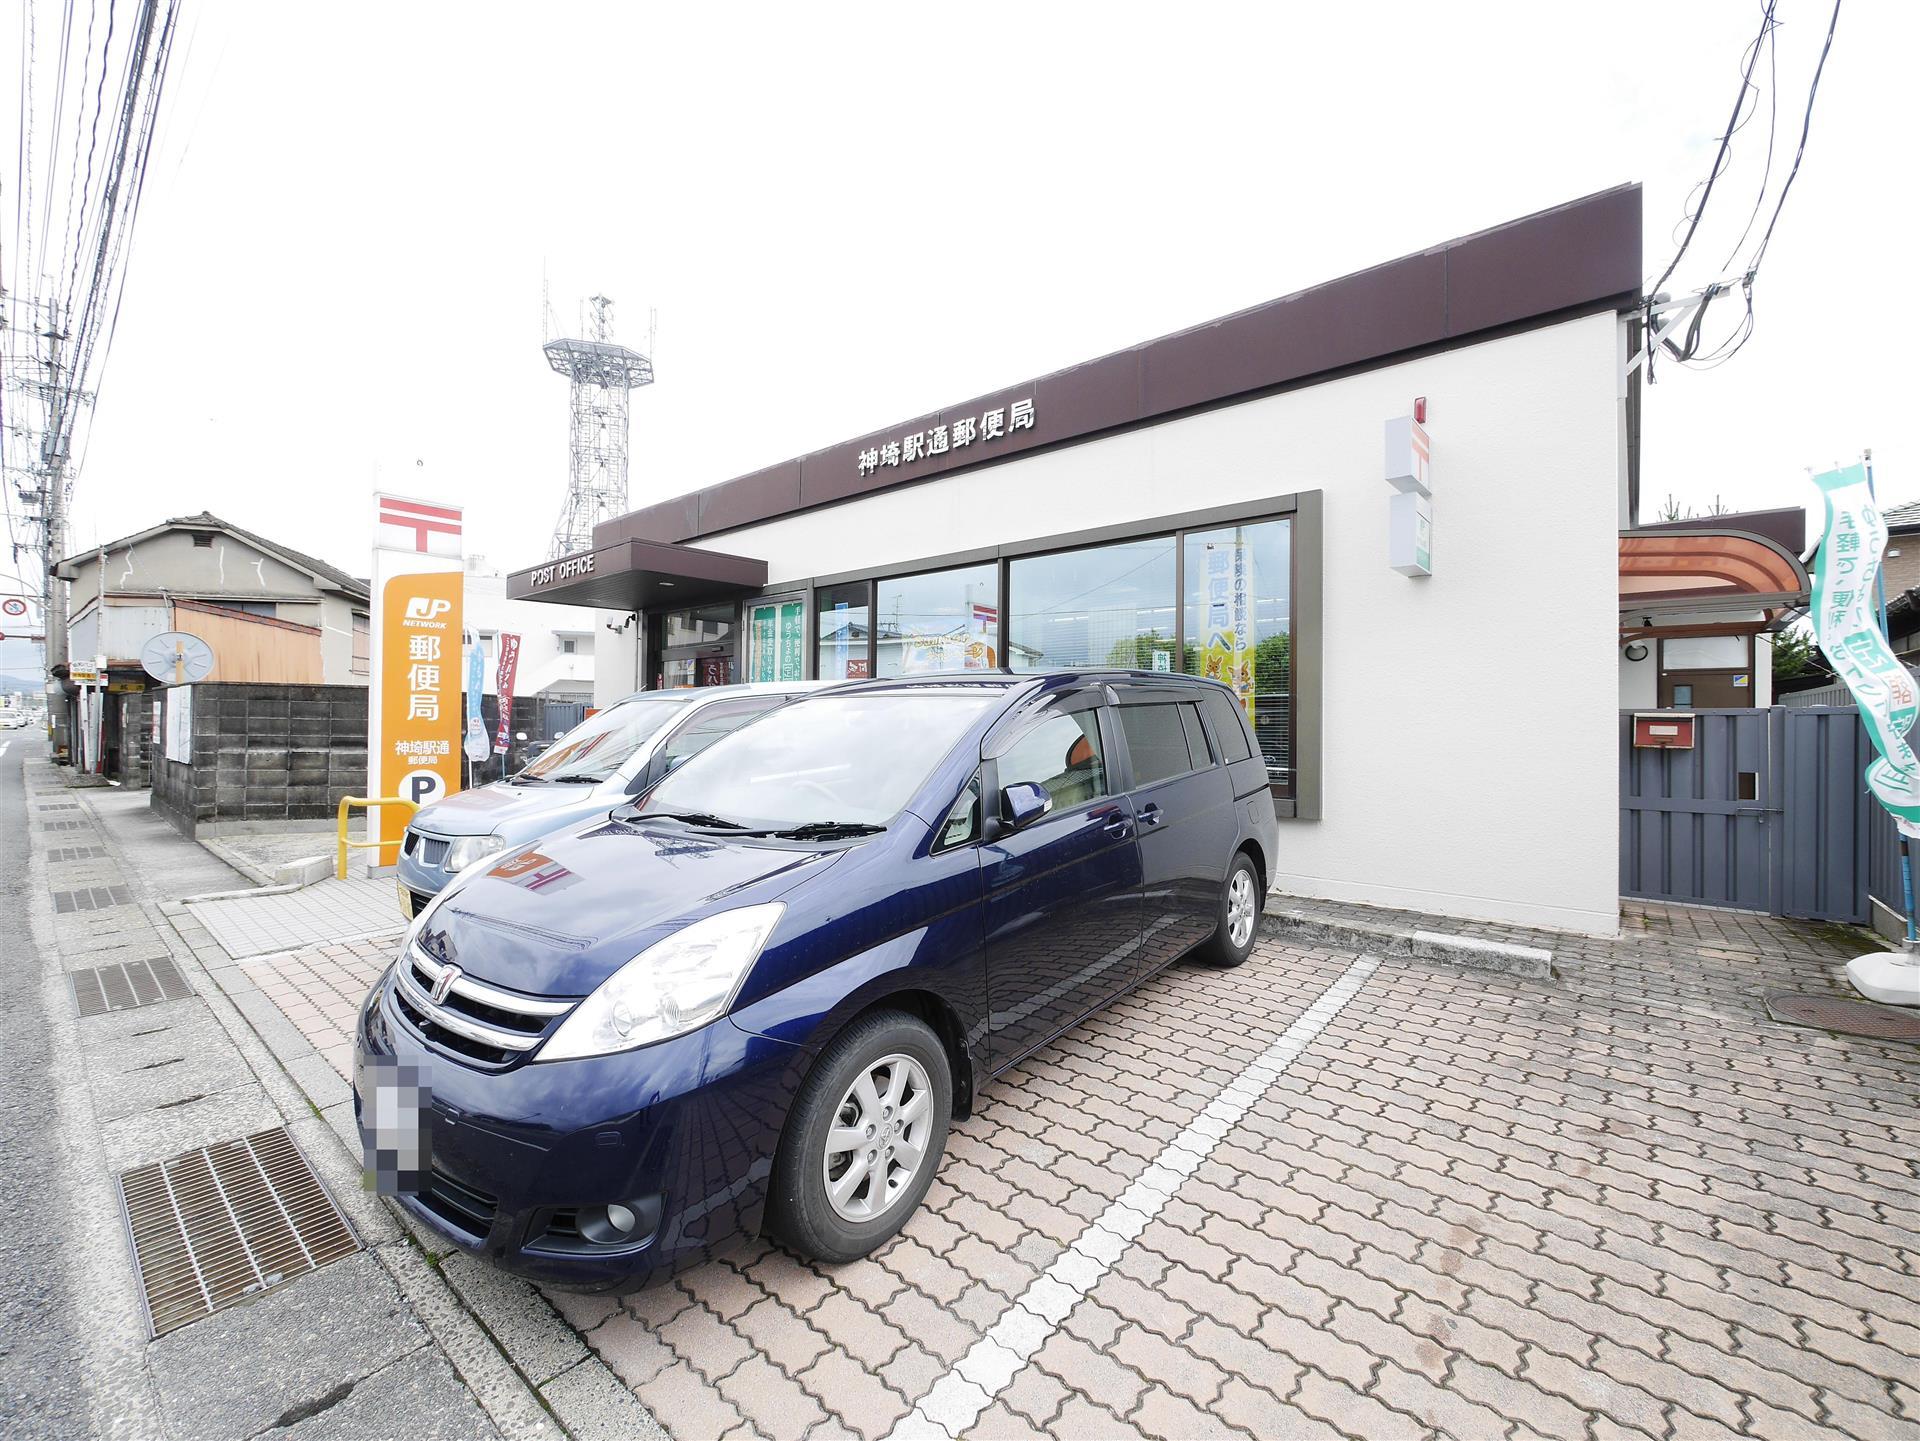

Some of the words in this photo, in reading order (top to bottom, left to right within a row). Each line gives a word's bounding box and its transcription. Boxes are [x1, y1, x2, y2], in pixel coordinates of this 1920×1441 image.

[858, 398, 1035, 477] 神埼駅通郵便局
[531, 566, 555, 587] POST
[559, 554, 595, 579] OFFICE
[404, 596, 452, 620] JP
[1208, 551, 1231, 651] 郵便局へ
[402, 619, 449, 630] NETWORK
[406, 634, 440, 722] 郵便局
[395, 740, 450, 756] 神埼駅通
[407, 755, 438, 765] 郵便局
[411, 776, 437, 804] P
